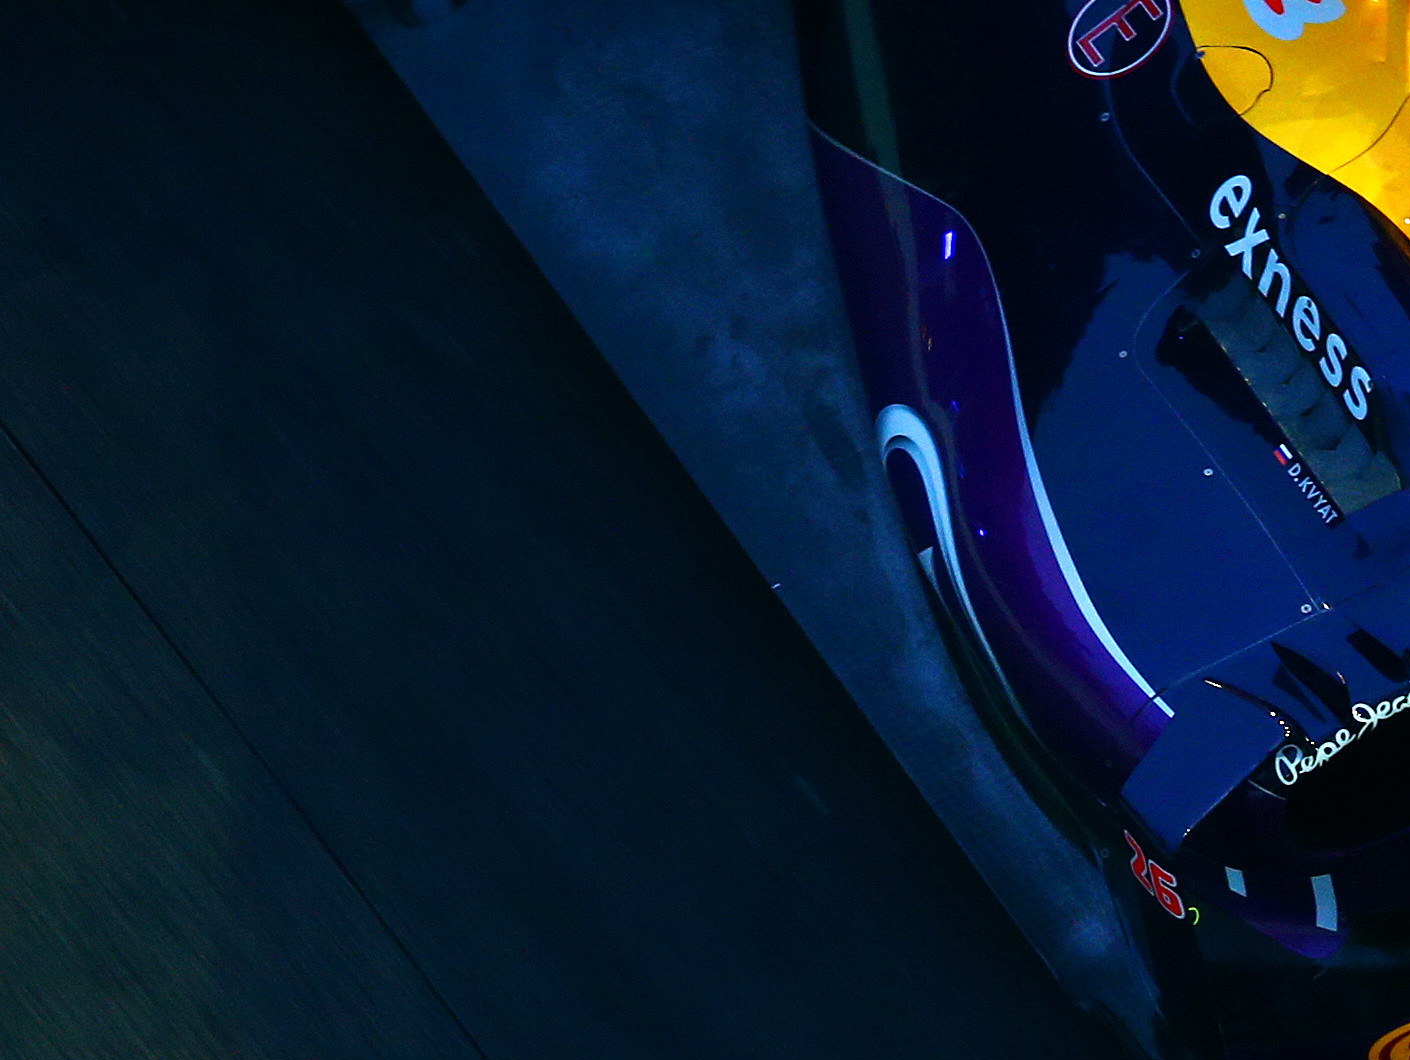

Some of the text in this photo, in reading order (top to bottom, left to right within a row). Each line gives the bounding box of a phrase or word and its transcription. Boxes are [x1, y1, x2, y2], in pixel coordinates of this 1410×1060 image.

[1209, 174, 1373, 420] exness
[1287, 462, 1339, 524] D.KVYAT
[1275, 728, 1356, 786] Pepe
[1123, 829, 1186, 920] 26
